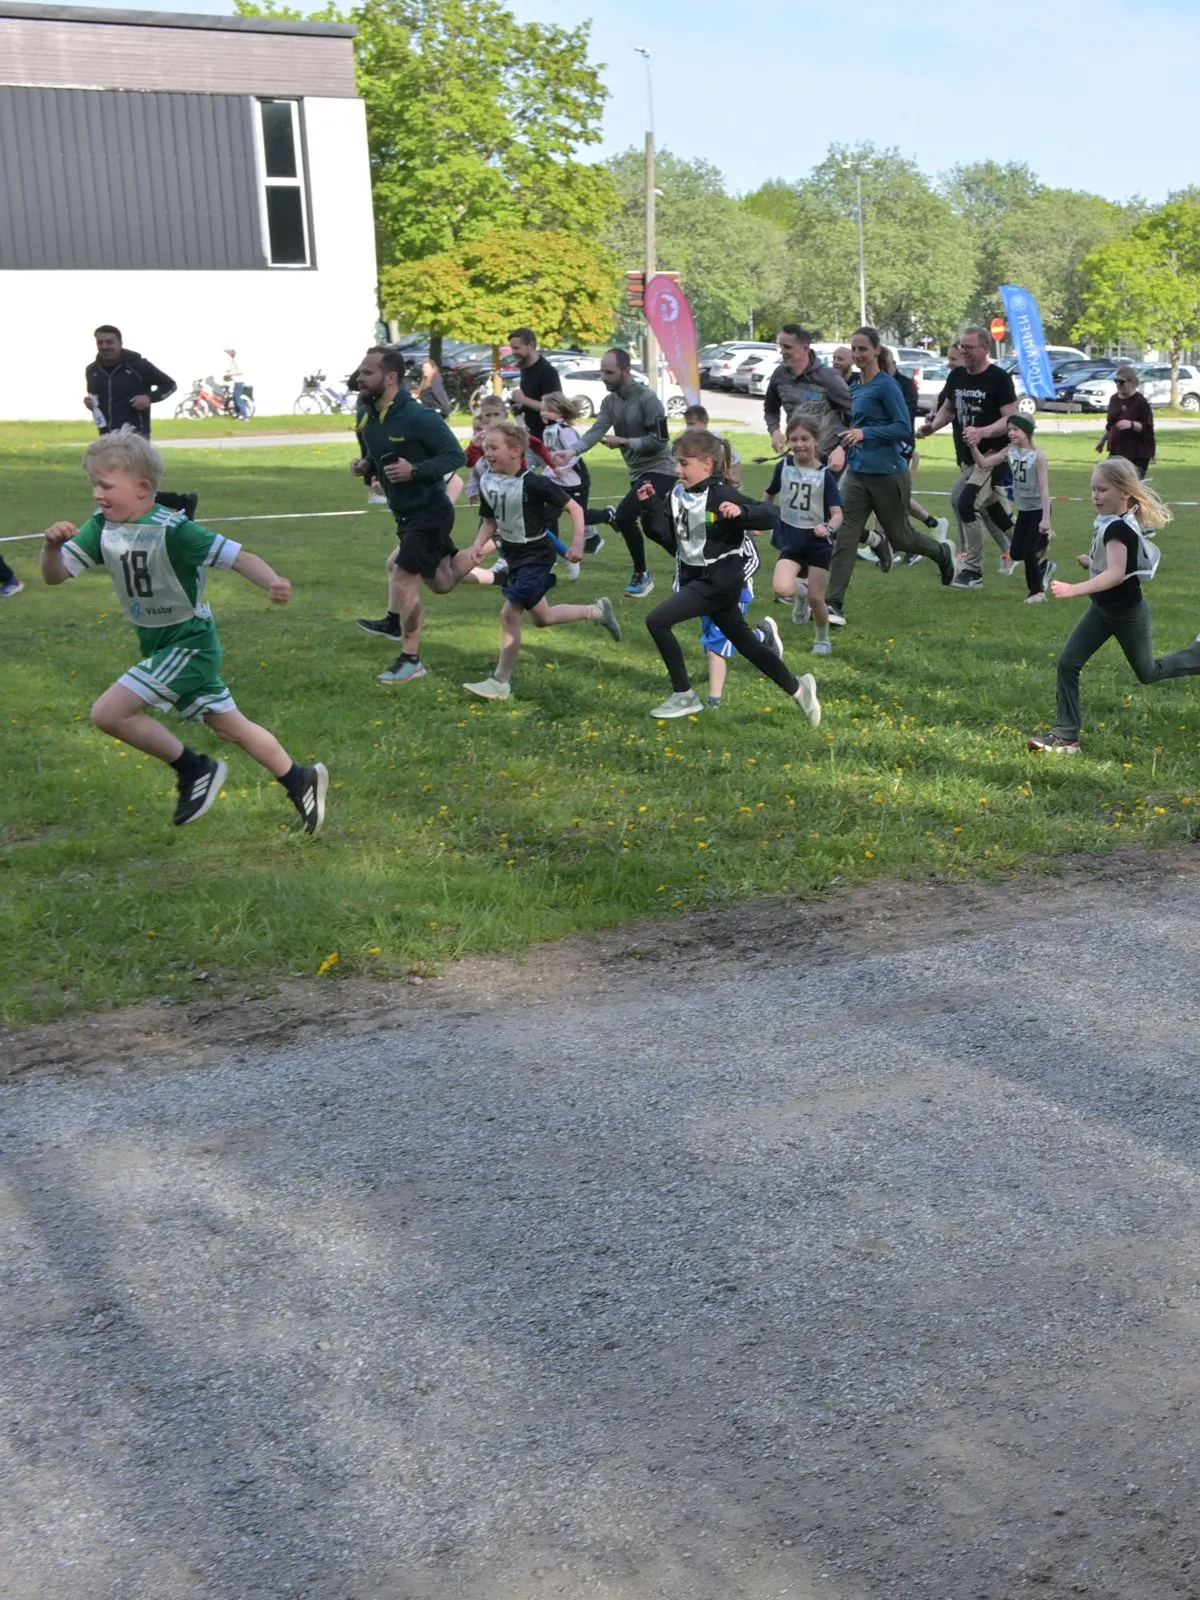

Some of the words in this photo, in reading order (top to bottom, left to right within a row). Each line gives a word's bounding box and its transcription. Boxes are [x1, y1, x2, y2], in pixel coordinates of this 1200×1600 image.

[1013, 459, 1027, 483] 25
[489, 489, 506, 522] 21
[789, 481, 812, 511] 23
[120, 551, 153, 598] 18
[145, 606, 173, 615] Väsby
